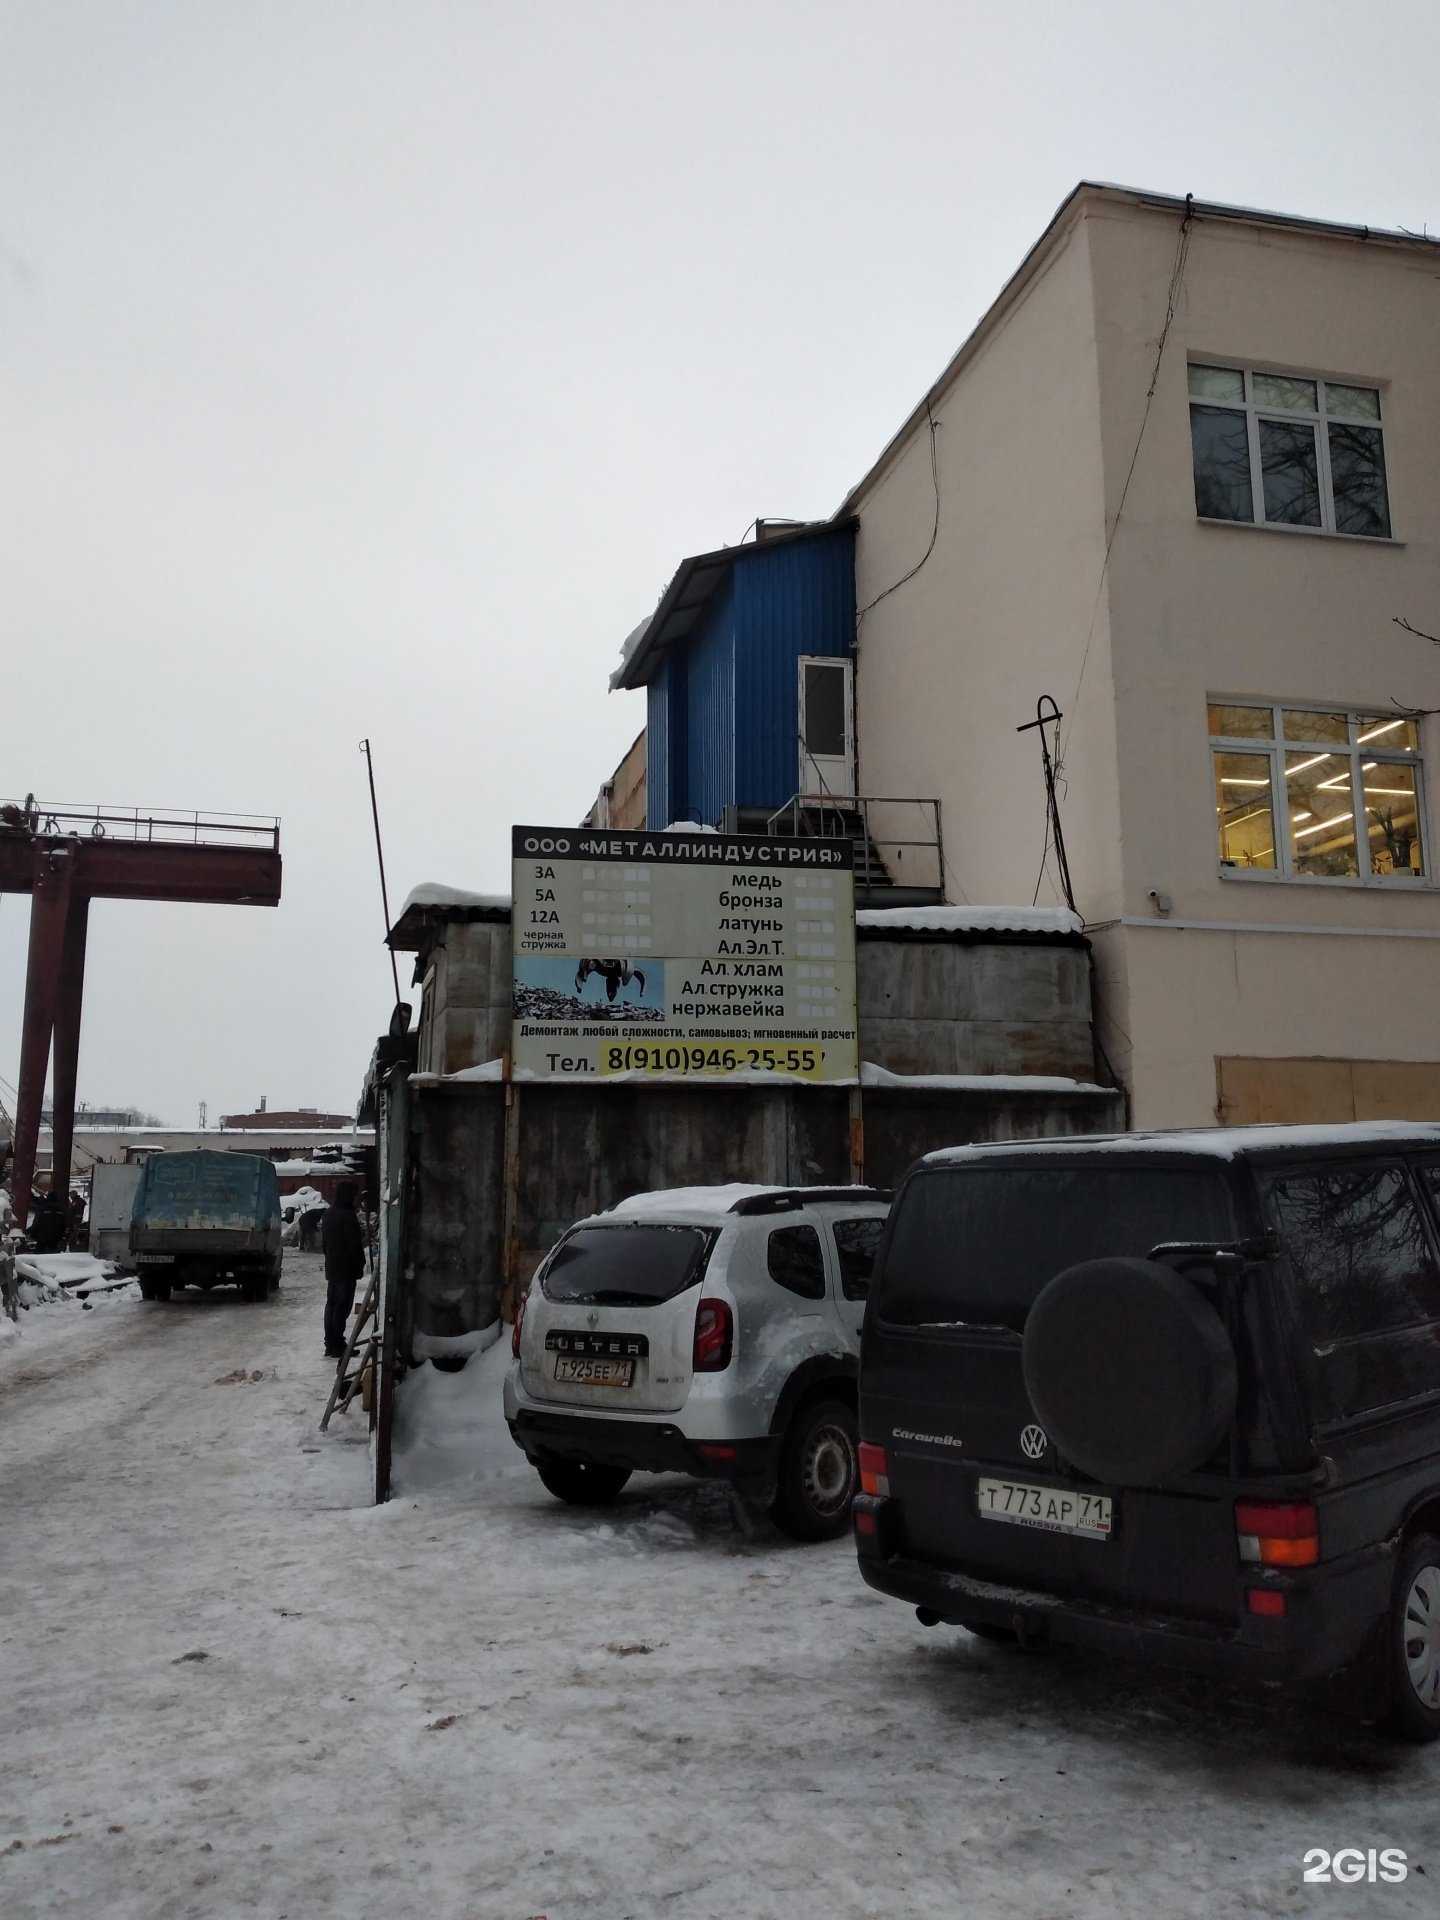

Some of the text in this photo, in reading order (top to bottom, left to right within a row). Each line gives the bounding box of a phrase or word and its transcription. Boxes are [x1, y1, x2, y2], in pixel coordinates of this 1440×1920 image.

[524, 838, 842, 863] ООО «МЕТАЛЛИНДУСТРИЯ»
[535, 866, 555, 880] 3А
[732, 874, 782, 891] медь
[535, 887, 555, 902] 5А
[719, 891, 783, 910] бронза
[530, 909, 560, 925] 12А
[718, 918, 784, 934] латунь
[523, 930, 564, 942] черная
[521, 940, 567, 952] стружка
[733, 963, 784, 977] хлам
[672, 1000, 785, 1019] нержавейка
[520, 1025, 579, 1037] Демонтаж
[582, 1026, 618, 1038] любой
[622, 1027, 686, 1039] сложности,
[753, 1028, 819, 1040] мгновенный
[821, 1030, 857, 1041] расчет
[546, 1053, 595, 1072] Тел.
[1079, 1517, 1097, 1528] RUS
